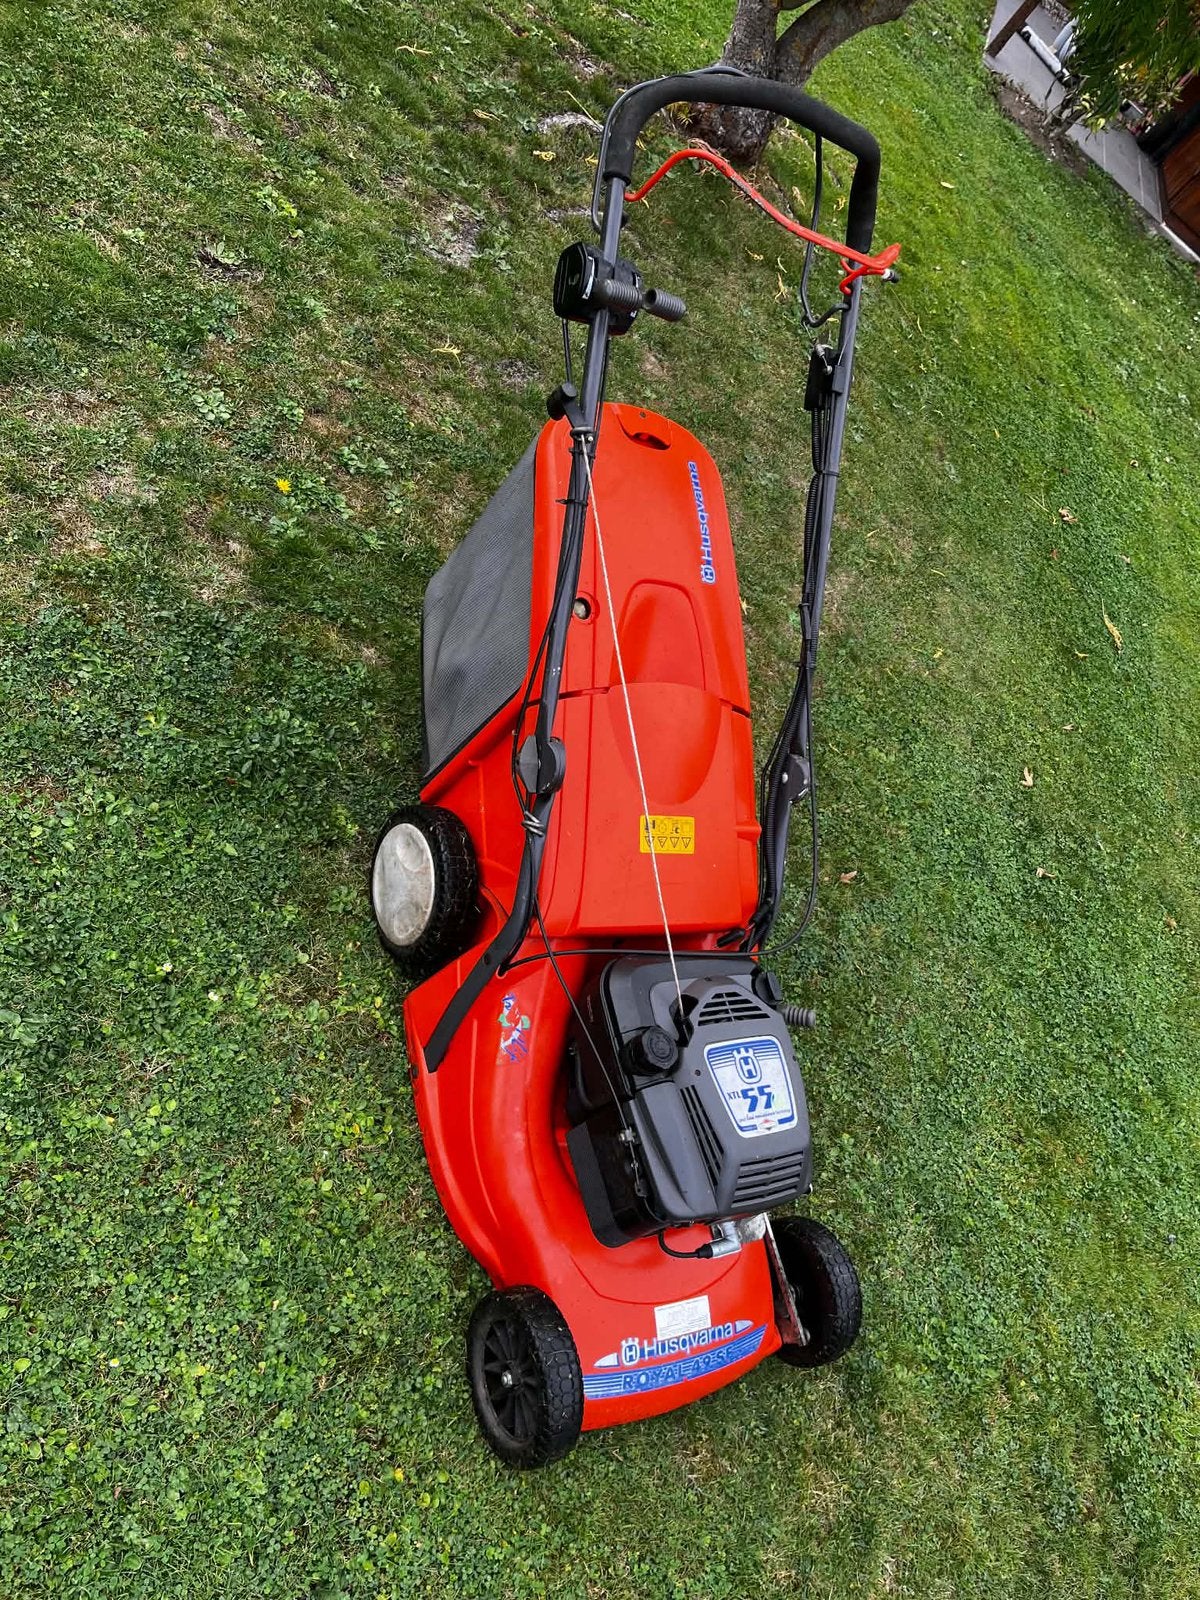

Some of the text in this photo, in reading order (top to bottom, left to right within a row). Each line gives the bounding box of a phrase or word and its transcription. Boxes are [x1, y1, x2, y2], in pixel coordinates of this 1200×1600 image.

[688, 461, 713, 562] Husqvarna
[740, 1085, 772, 1113] 55
[643, 1322, 733, 1360] Husqvarna
[622, 1364, 690, 1390] ROYAL
